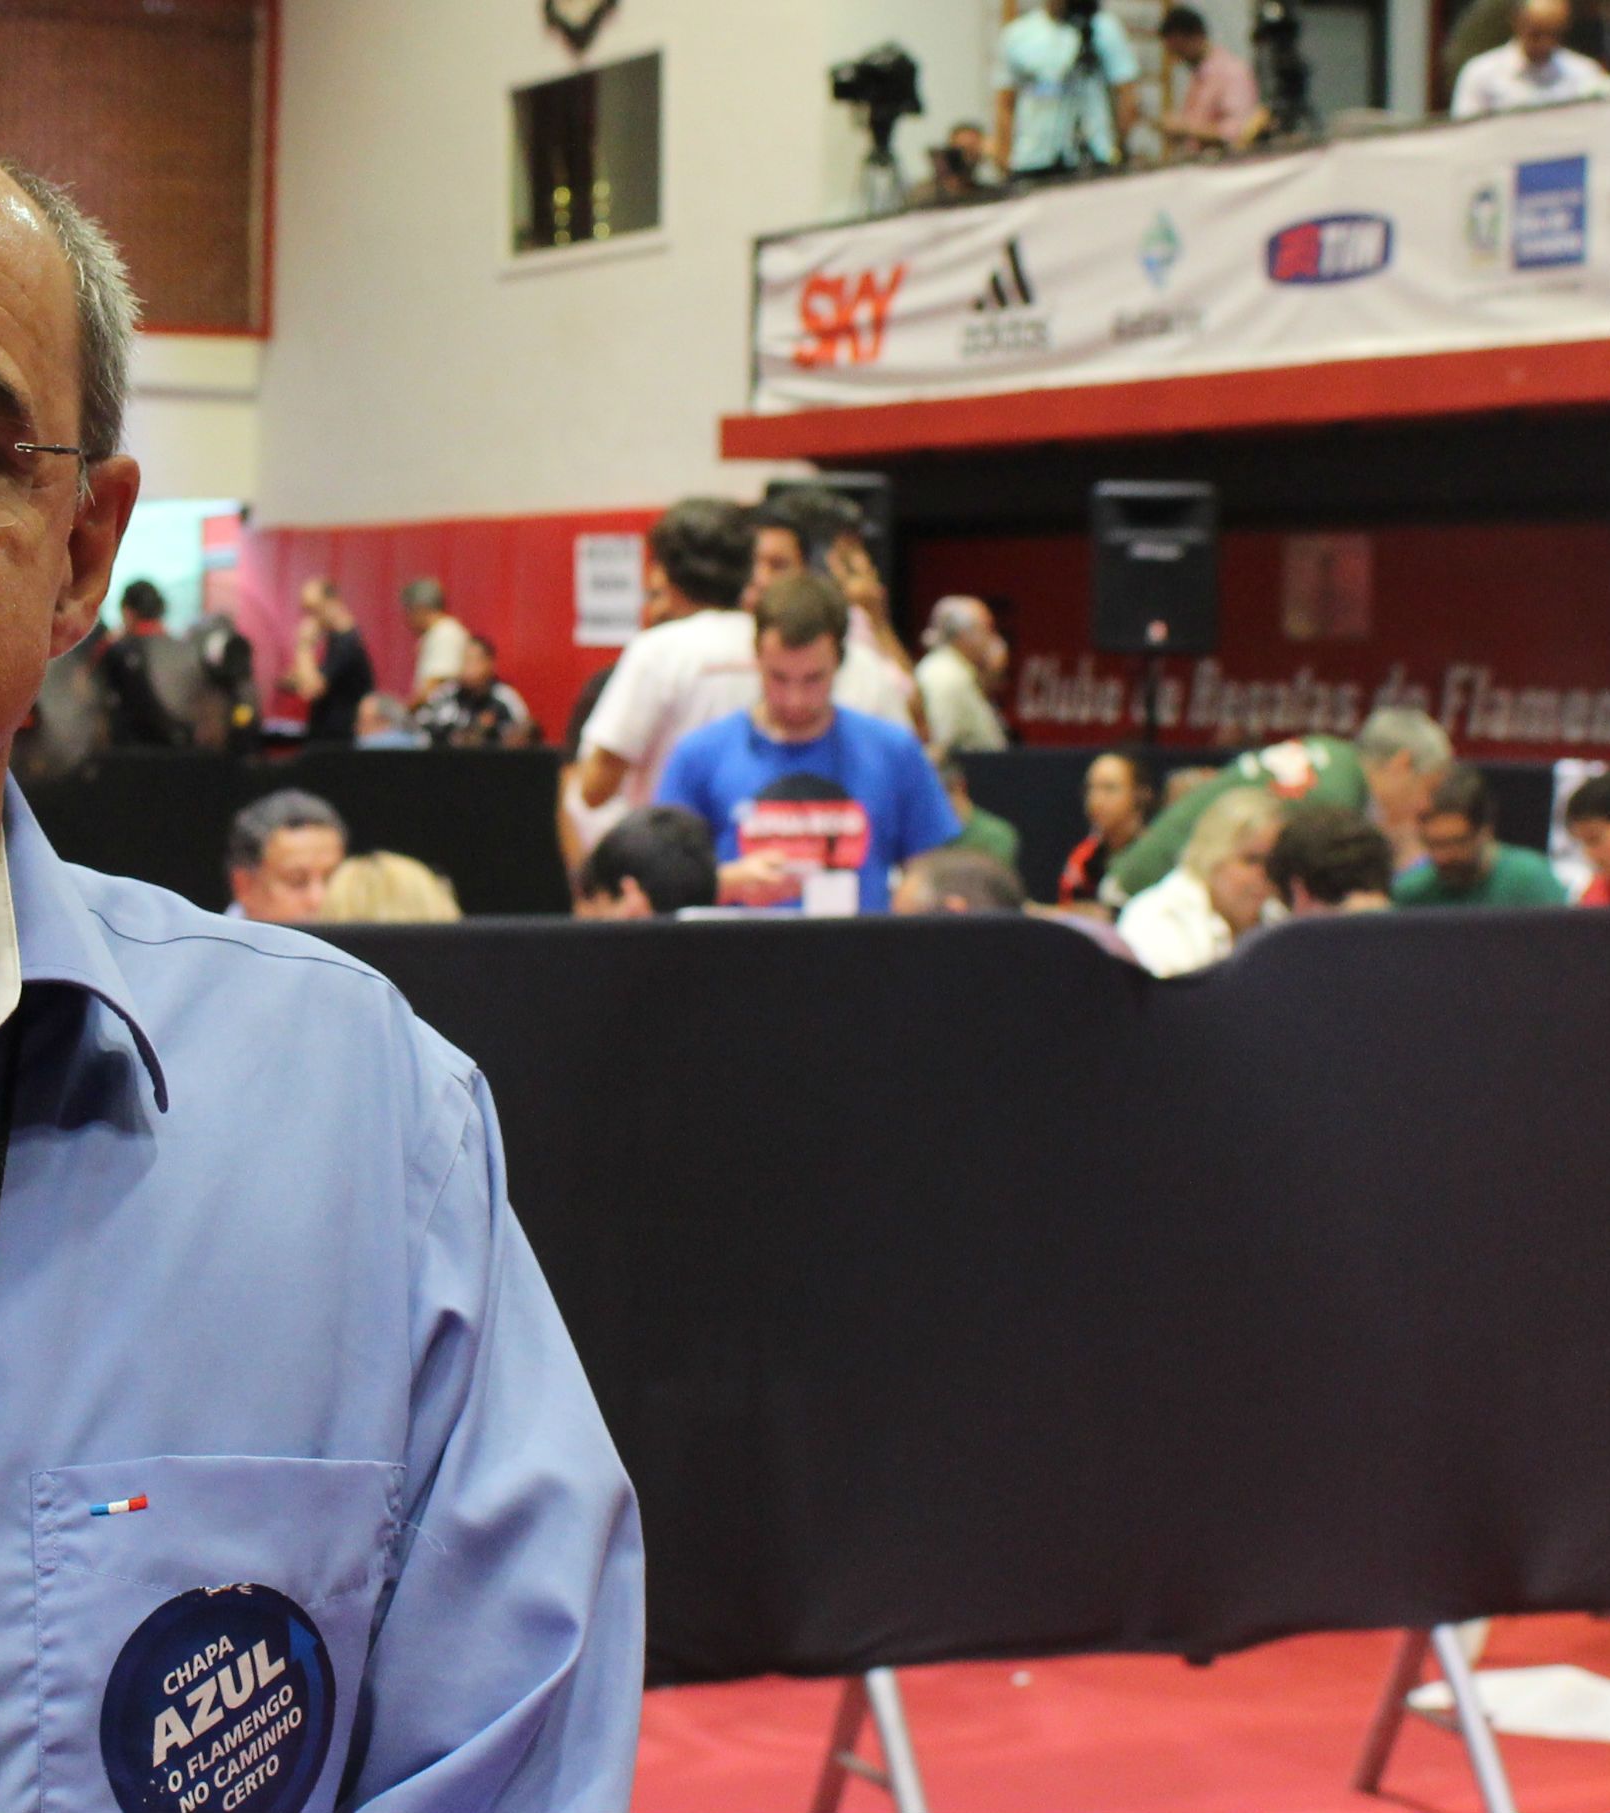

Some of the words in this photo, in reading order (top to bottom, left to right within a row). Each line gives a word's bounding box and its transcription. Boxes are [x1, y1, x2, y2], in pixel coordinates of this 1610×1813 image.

[792, 262, 908, 370] SKY
[1017, 653, 1127, 726] Clube
[1186, 656, 1365, 733] Regatas
[152, 1639, 286, 1767] AZUL
[163, 1635, 235, 1696] CHAPA
[167, 1769, 184, 1793] O
[186, 1684, 294, 1779] FLAMENGO
[178, 1781, 210, 1813] NO
[213, 1706, 303, 1789] CAMINHO
[222, 1756, 280, 1811] CERTO
